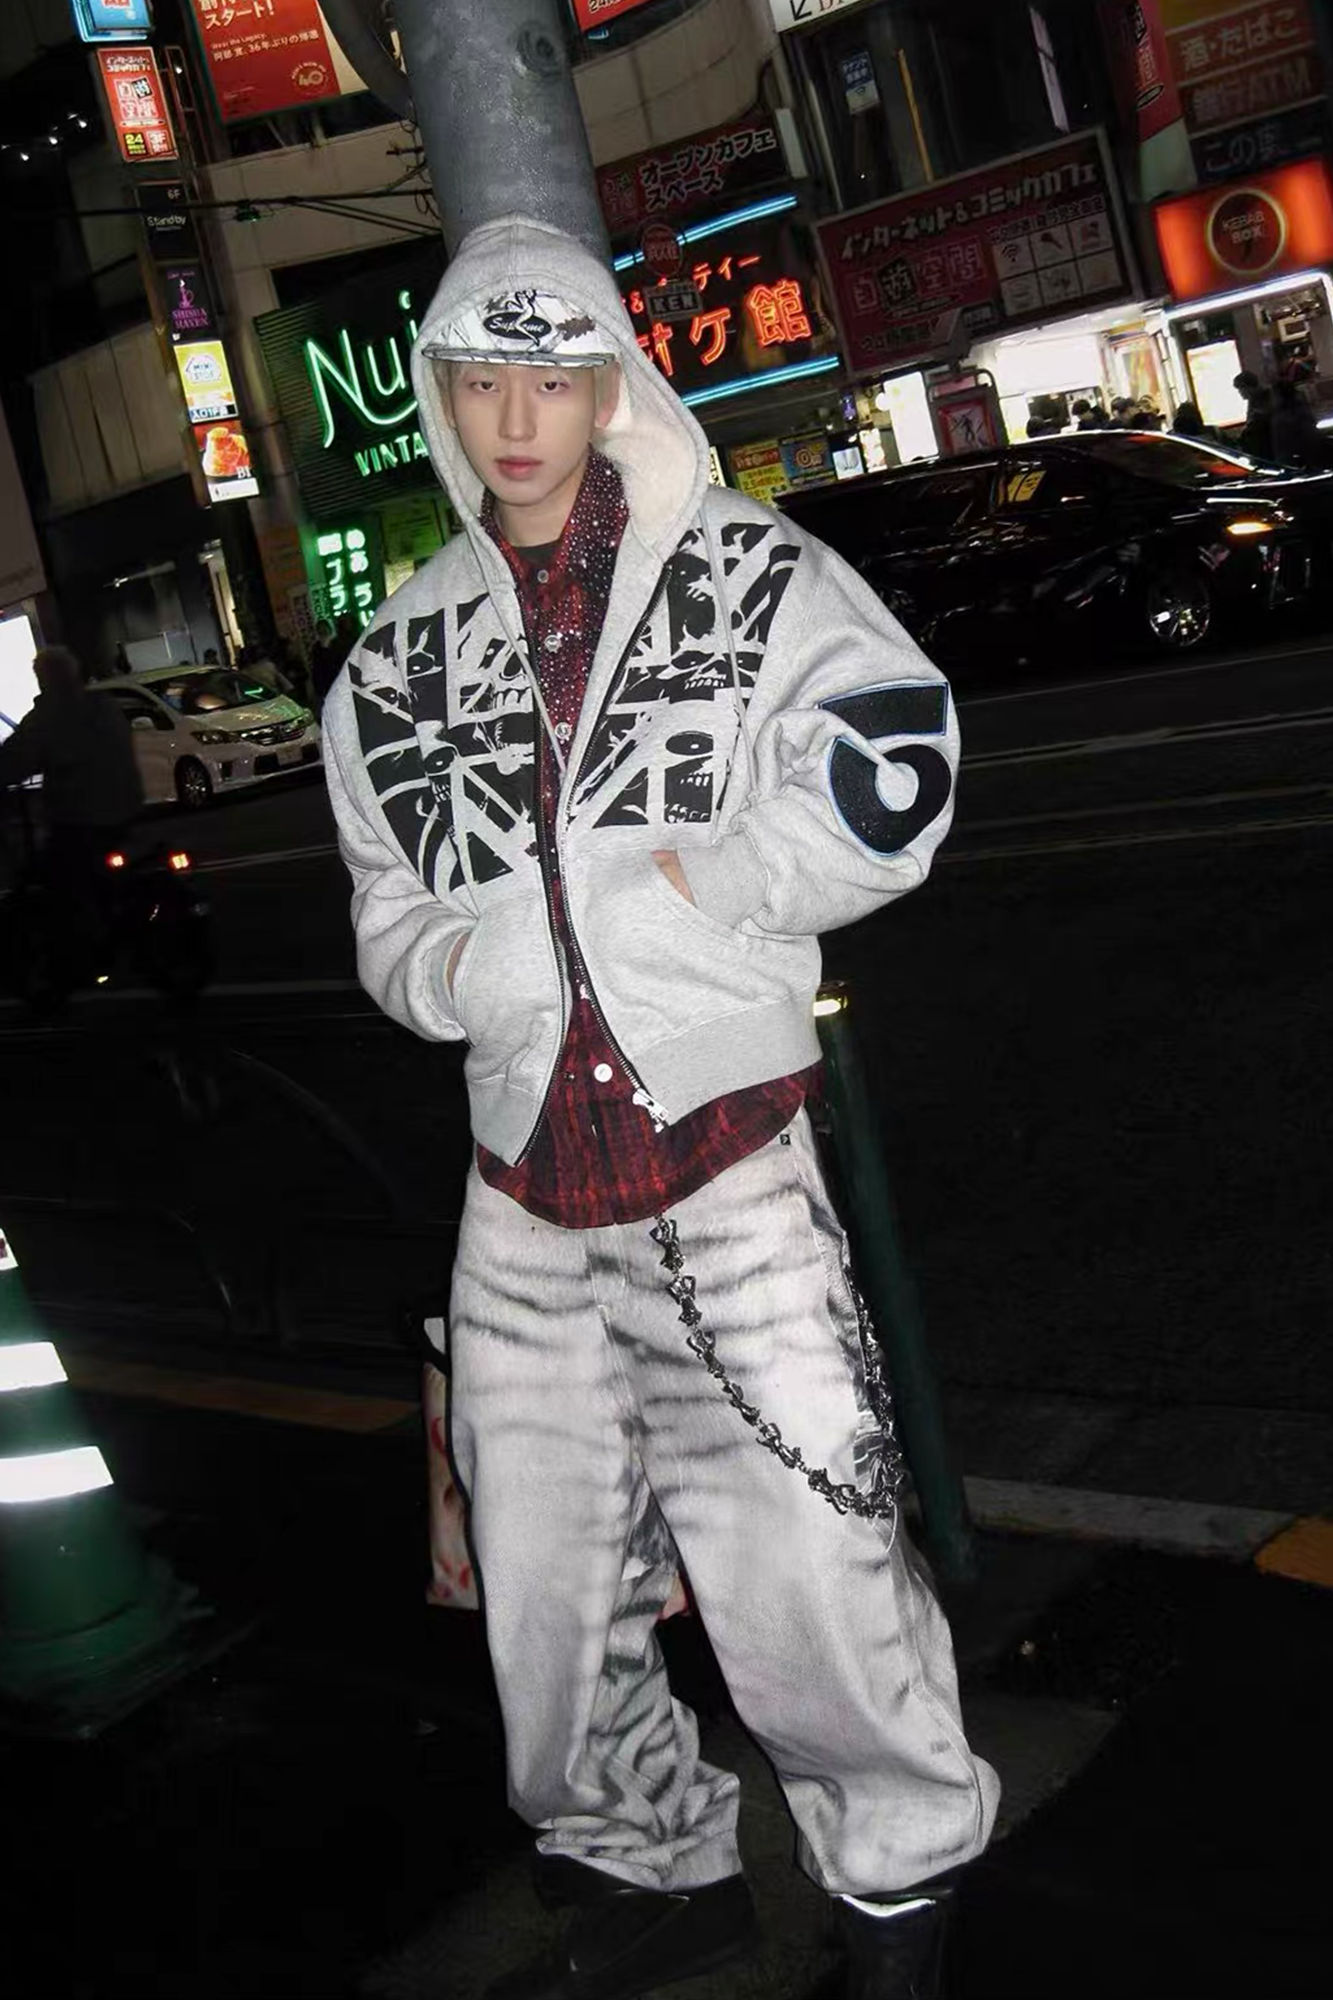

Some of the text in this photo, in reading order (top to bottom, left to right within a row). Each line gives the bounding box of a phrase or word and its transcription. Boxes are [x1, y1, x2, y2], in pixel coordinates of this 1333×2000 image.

[125, 133, 144, 145] 24
[639, 128, 777, 188] オープンカフェ
[645, 168, 726, 212] スペース
[147, 214, 187, 227] Standby
[1221, 210, 1266, 231] KEBAB
[1230, 227, 1263, 244] BOX
